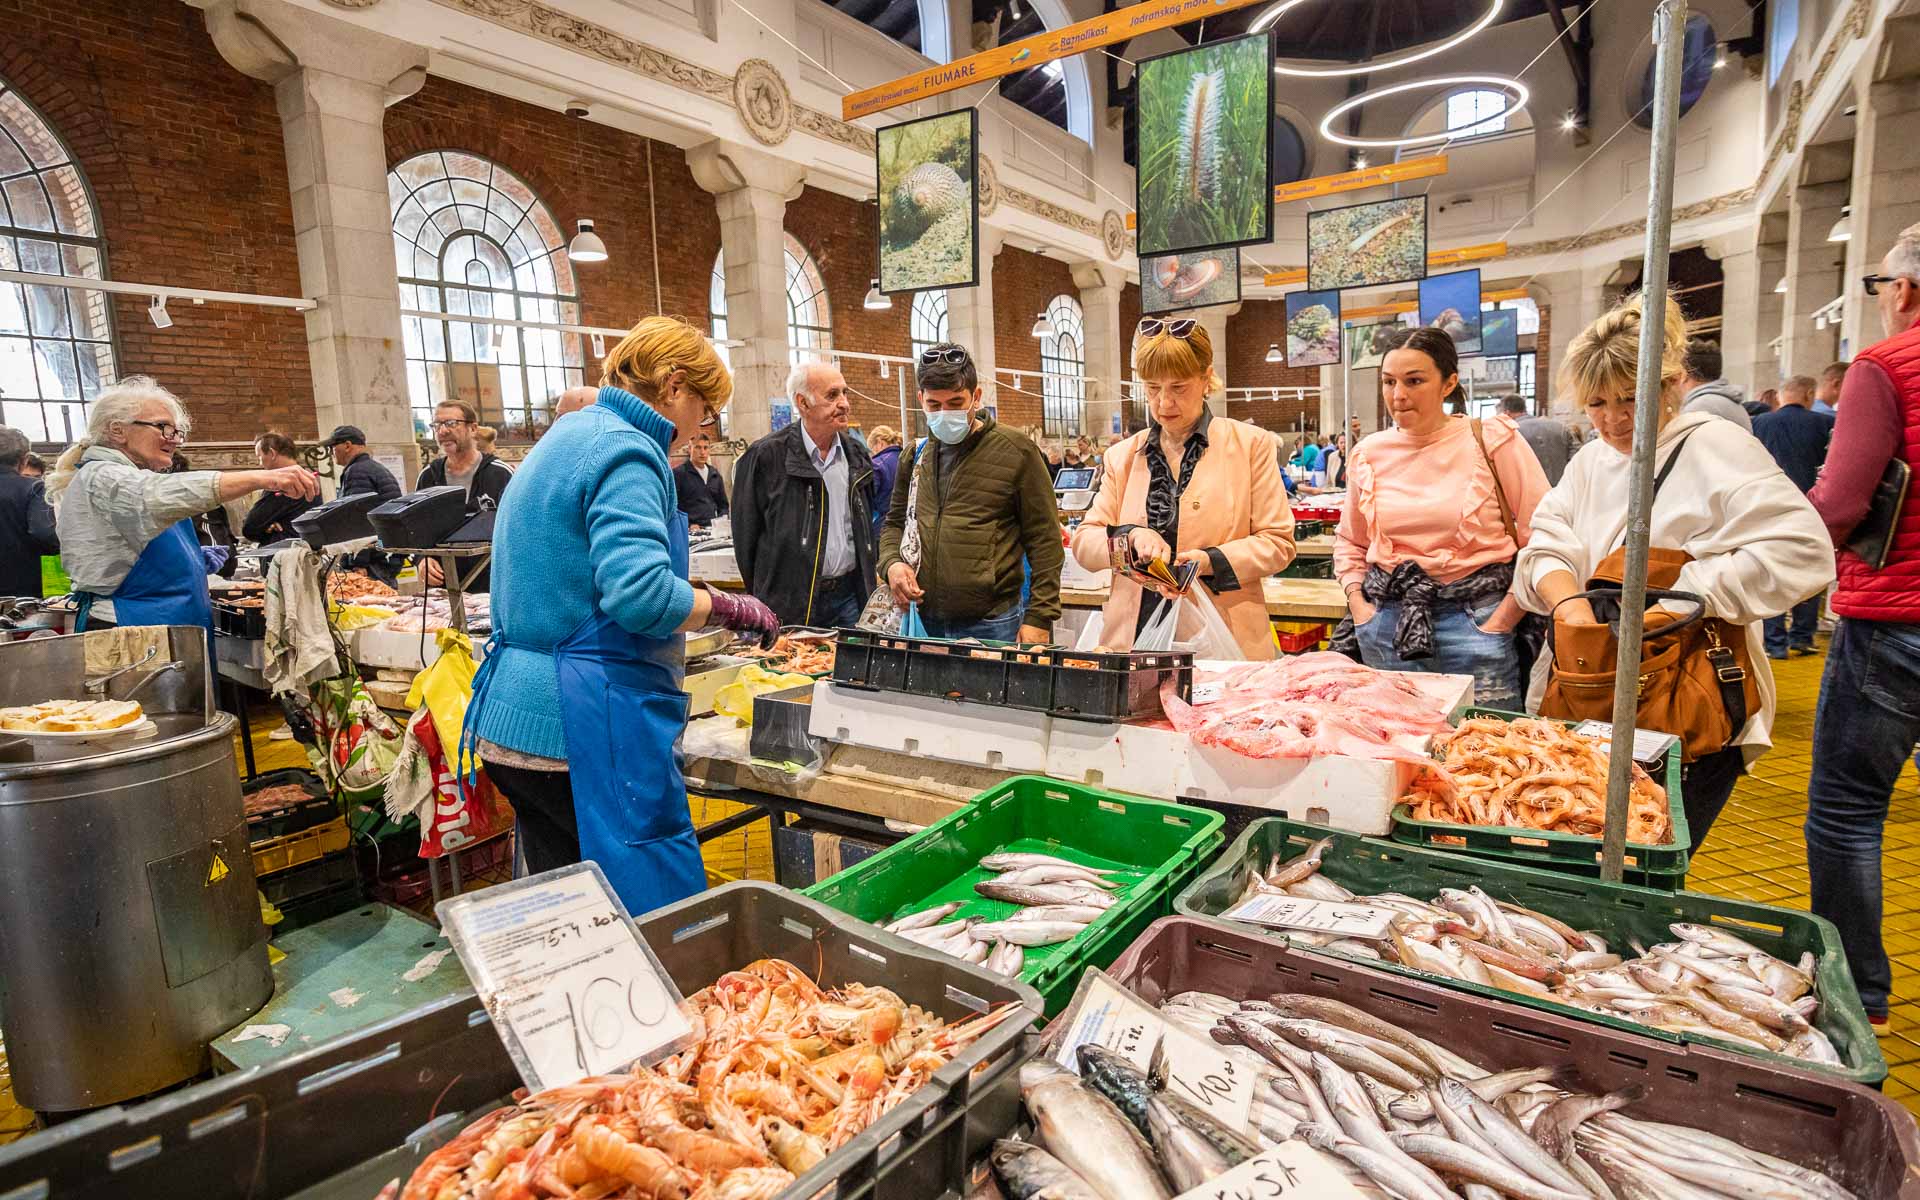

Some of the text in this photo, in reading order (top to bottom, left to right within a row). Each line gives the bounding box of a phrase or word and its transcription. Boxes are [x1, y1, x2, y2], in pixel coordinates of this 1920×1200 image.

[1060, 25, 1109, 47] Raznolikost
[1130, 4, 1181, 27] Jadranskog
[924, 63, 976, 88] FIUMARE
[565, 969, 670, 1077] 160
